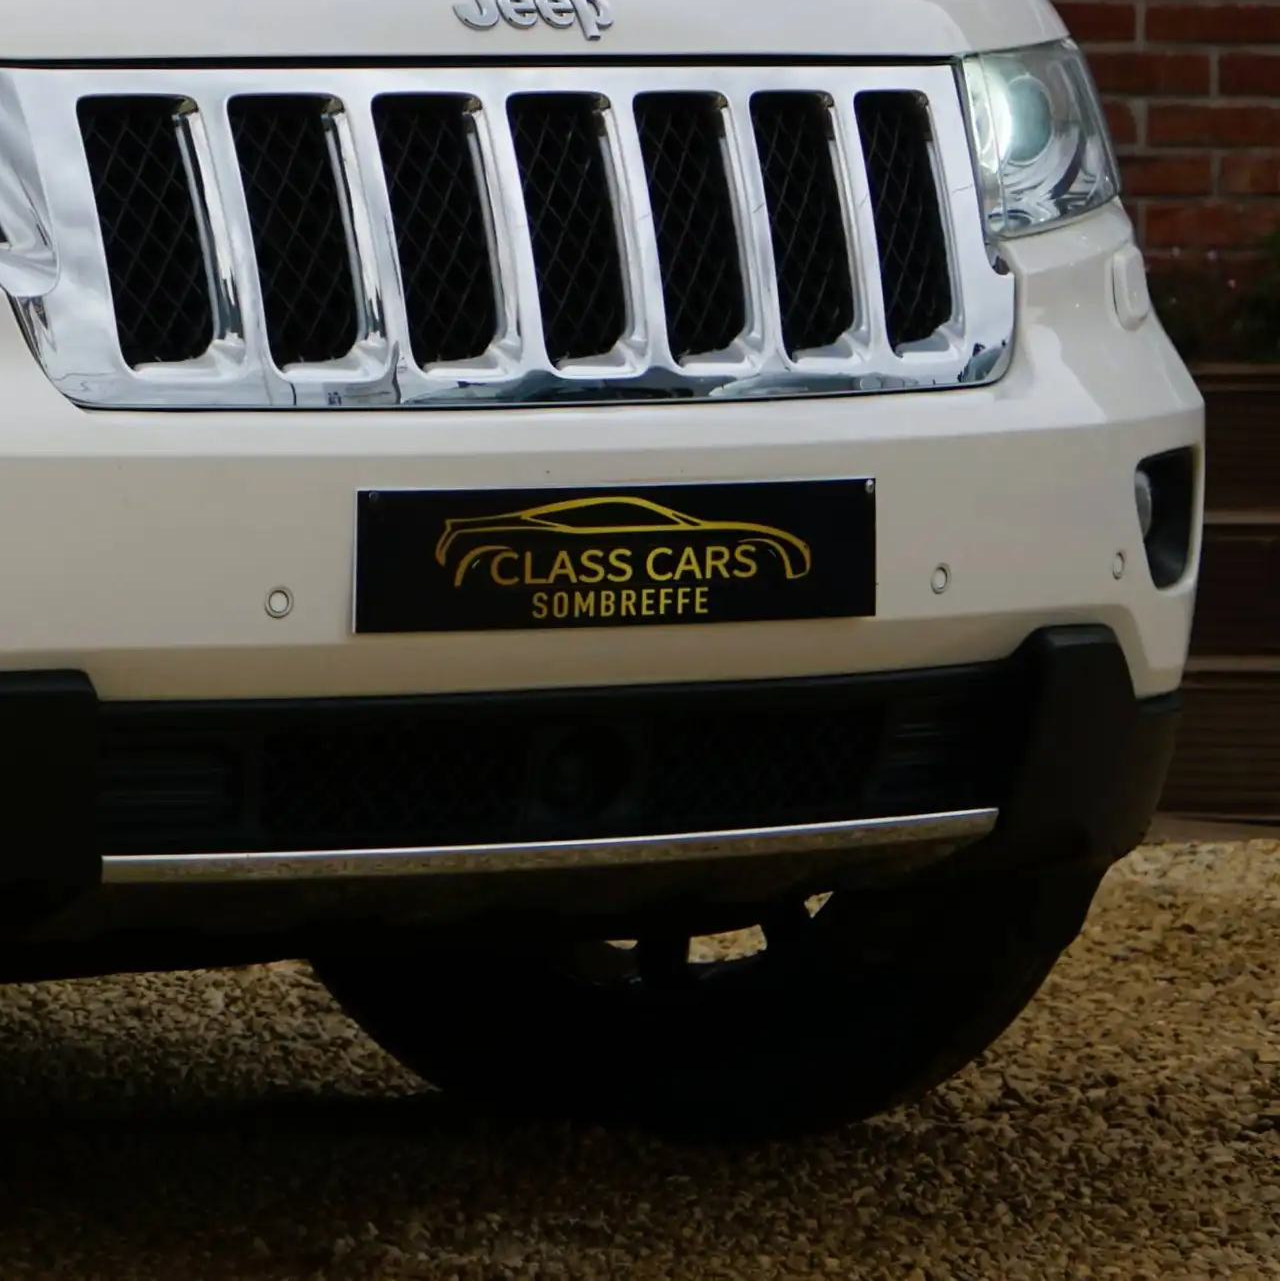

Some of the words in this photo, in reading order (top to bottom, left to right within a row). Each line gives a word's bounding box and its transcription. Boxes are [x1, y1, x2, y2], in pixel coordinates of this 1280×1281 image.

[490, 548, 633, 586] CLASS
[645, 544, 757, 579] CARS
[531, 587, 709, 618] SOMBREFFE
